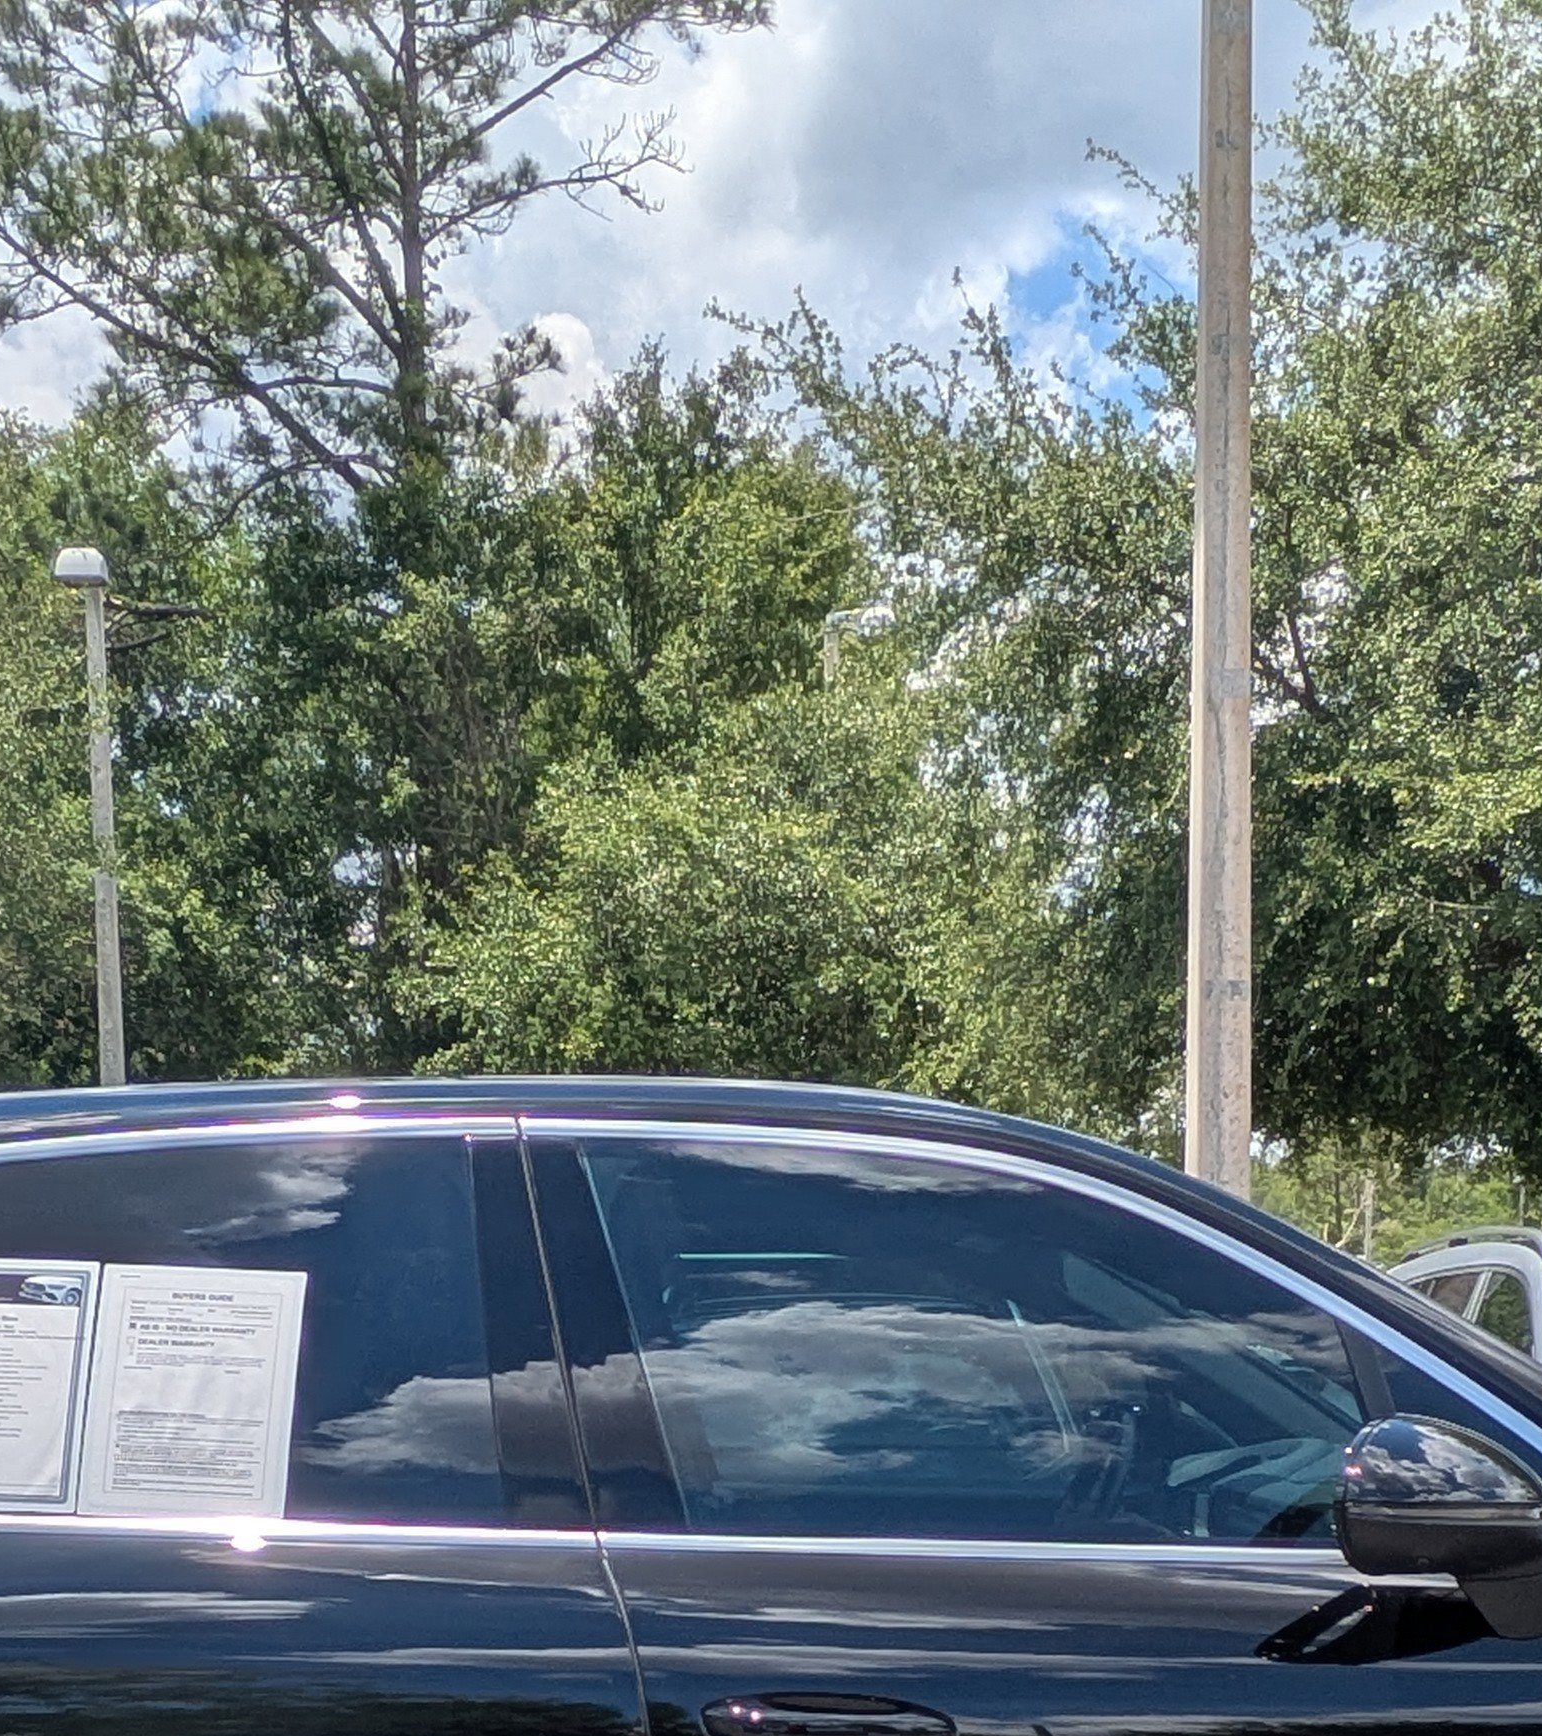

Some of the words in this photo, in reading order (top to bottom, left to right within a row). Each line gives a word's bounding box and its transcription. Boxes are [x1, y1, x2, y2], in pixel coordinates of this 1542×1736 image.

[172, 1292, 206, 1301] BUYERS
[208, 1293, 234, 1302] GUIDE
[179, 1325, 211, 1333] DEALER
[212, 1327, 256, 1335] WARRANTY
[137, 1338, 169, 1346] DEALER
[171, 1339, 215, 1347] WARRANTY
